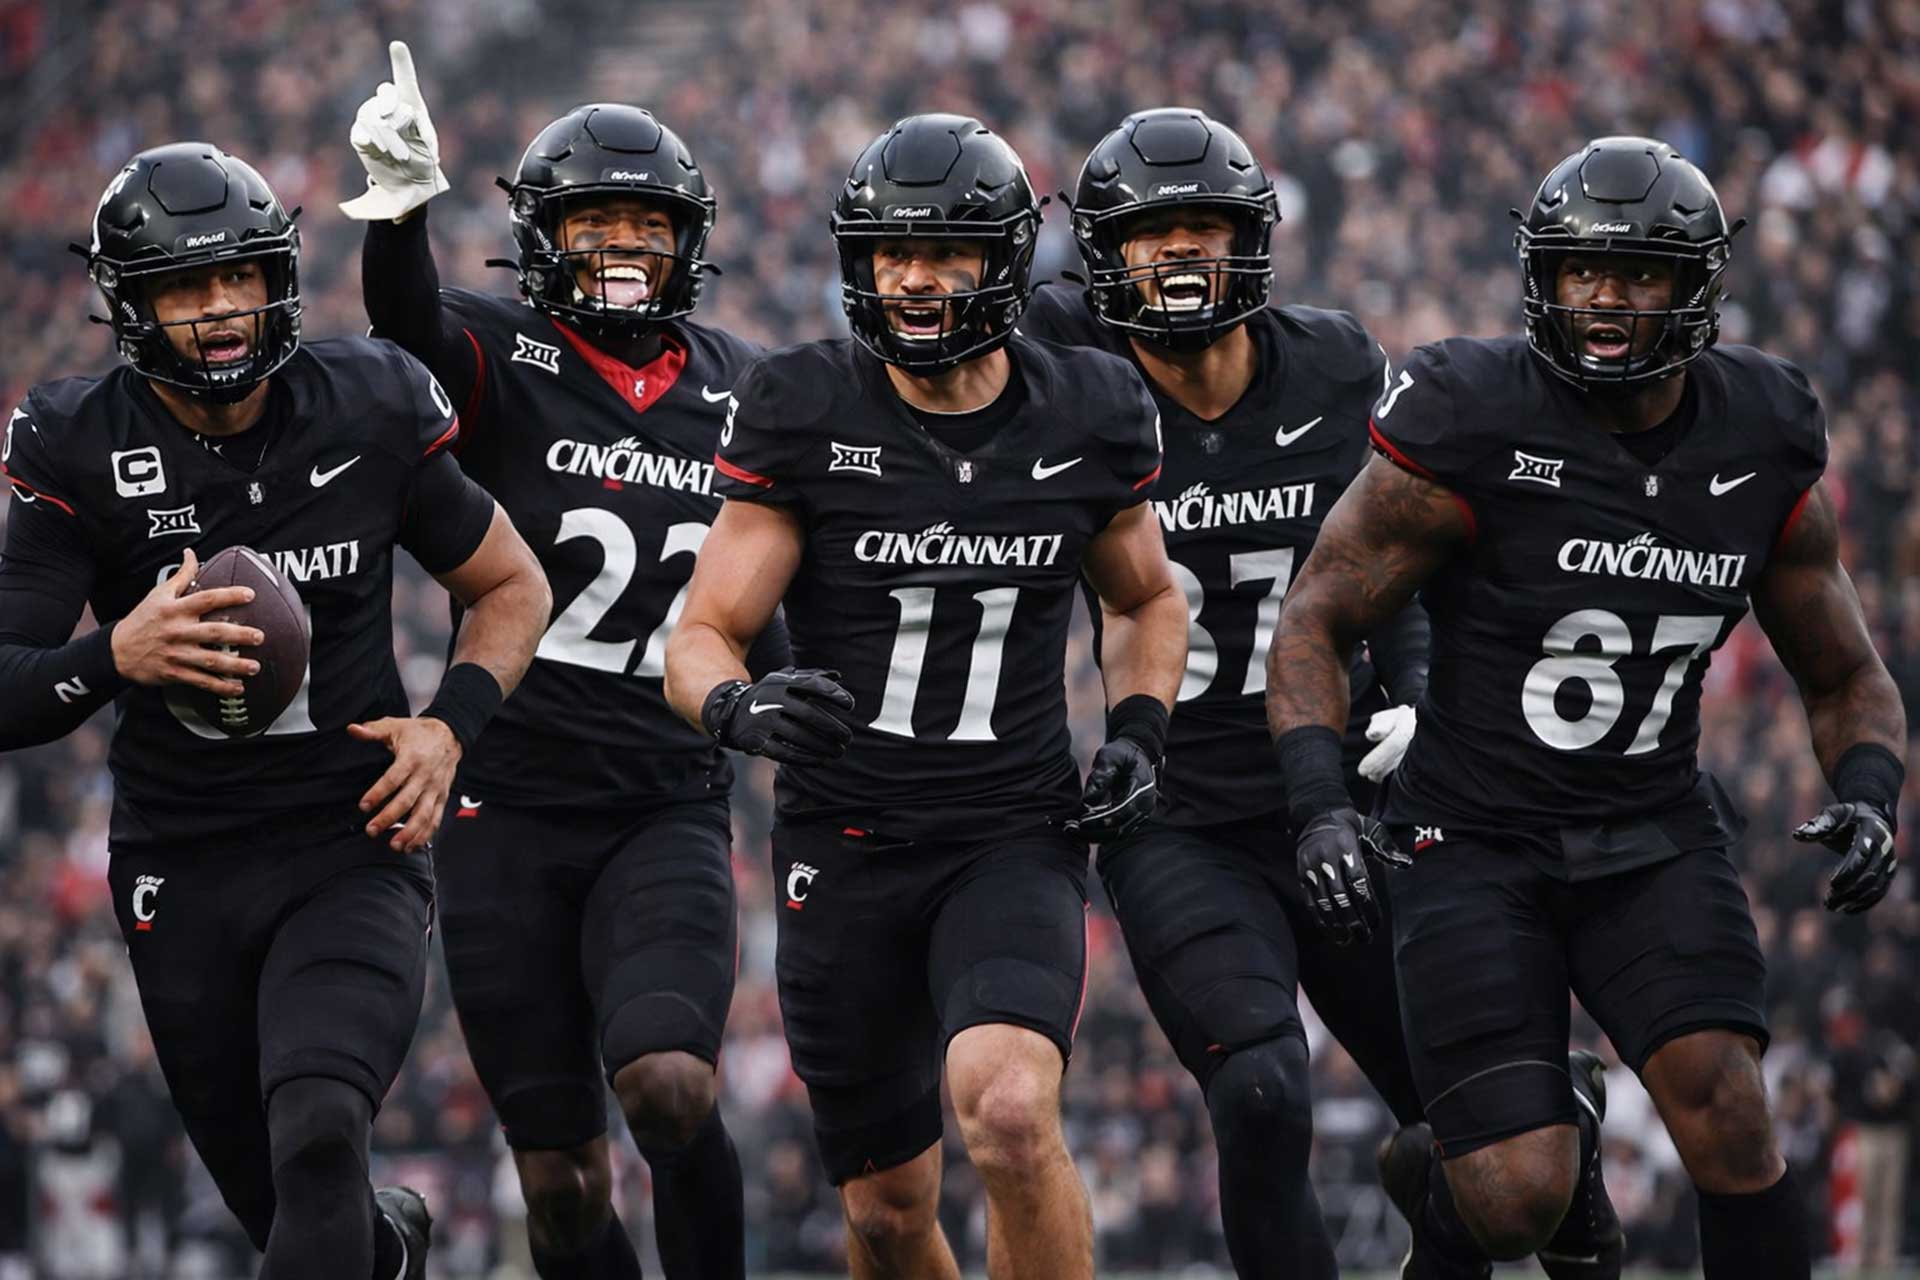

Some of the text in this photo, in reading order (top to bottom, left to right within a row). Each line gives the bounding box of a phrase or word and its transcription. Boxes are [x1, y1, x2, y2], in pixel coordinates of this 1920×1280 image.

[511, 333, 561, 375] XII
[118, 451, 159, 484] C
[546, 436, 726, 499] CINCINNAT
[828, 441, 882, 477] XII
[1508, 450, 1564, 488] XII
[1150, 481, 1316, 532] NCINNATI
[854, 522, 1064, 567] CINCINNATI
[1557, 532, 1746, 588] CINCINNATI
[536, 507, 713, 678] 22
[868, 587, 1020, 741] 11
[1521, 609, 1724, 756] 87
